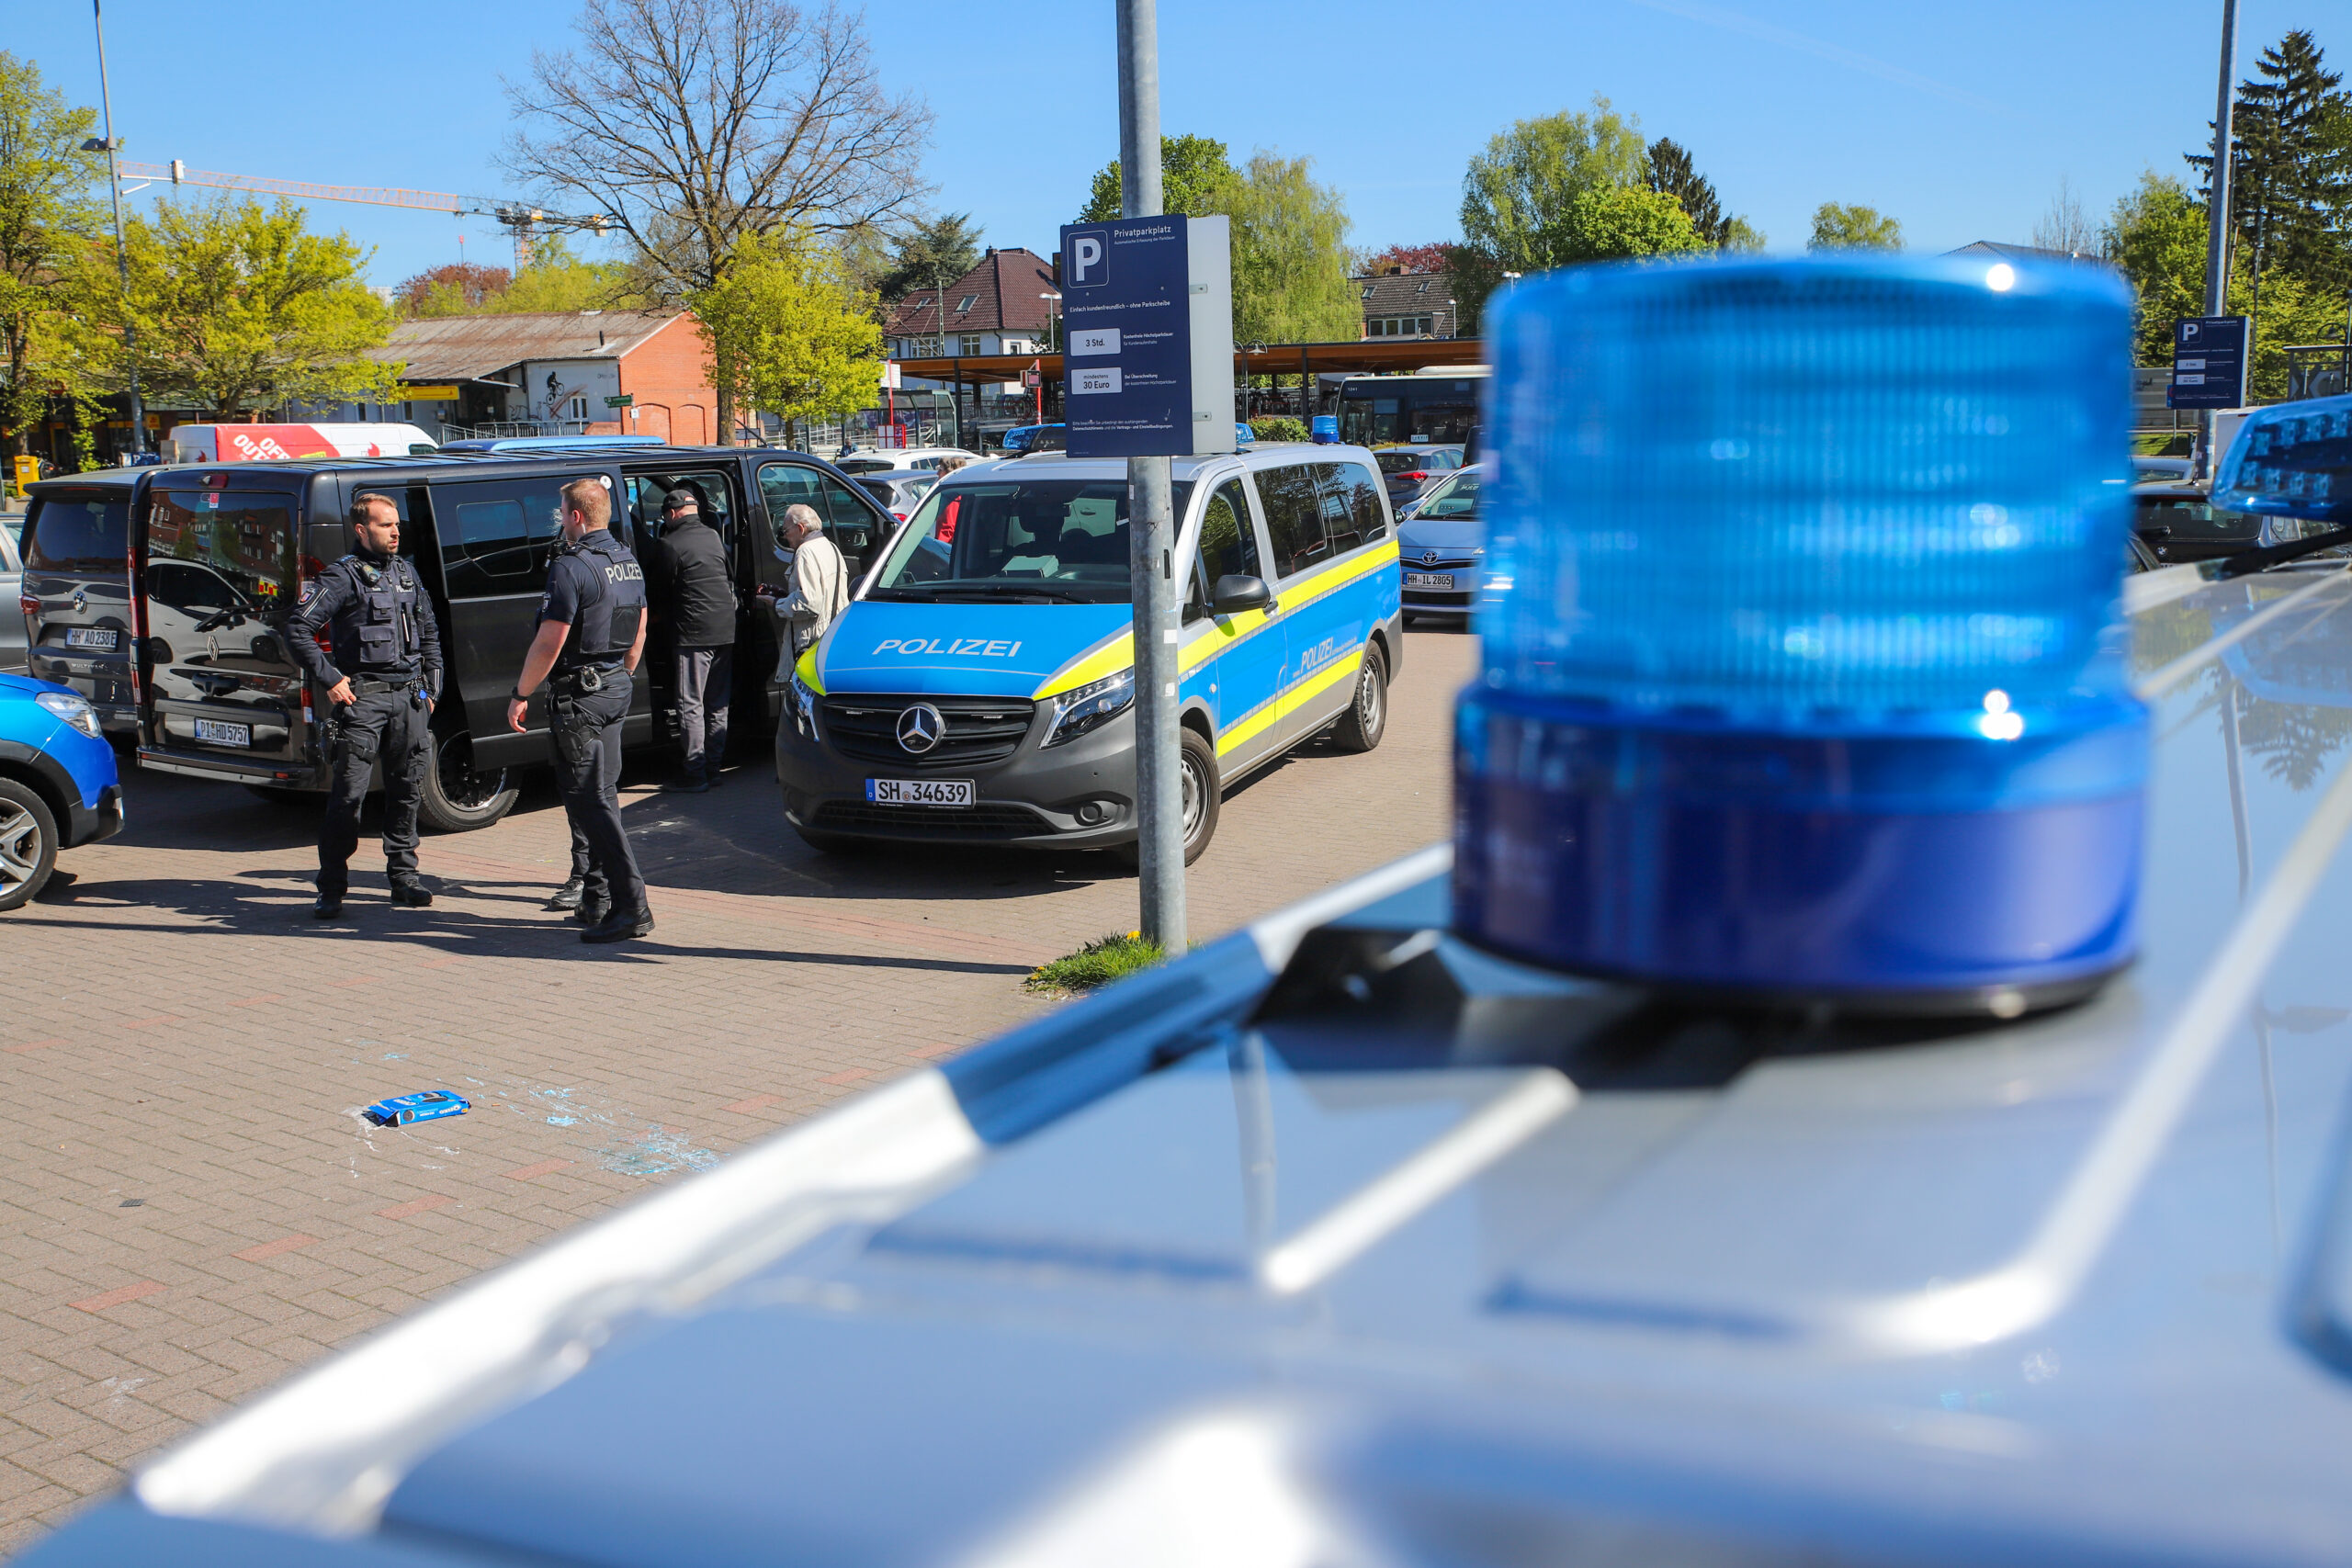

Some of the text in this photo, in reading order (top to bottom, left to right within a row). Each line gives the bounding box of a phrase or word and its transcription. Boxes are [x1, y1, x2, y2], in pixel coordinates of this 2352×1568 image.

[1114, 225, 1171, 238] Privatparkplatz
[1074, 237, 1102, 282] P
[1087, 303, 1125, 311] kundenfreundlich
[2183, 323, 2199, 341] P
[1091, 338, 1105, 346] Std.
[1083, 381, 1092, 389] 30
[605, 563, 643, 584] POLIZEI
[1408, 575, 1451, 584] HH IL 2805
[72, 630, 81, 644] HH
[871, 638, 1023, 657] POLIZEI
[1300, 637, 1333, 674] POLIZEI
[200, 721, 247, 743] PI HD 5757
[878, 781, 967, 803] SH 34639
